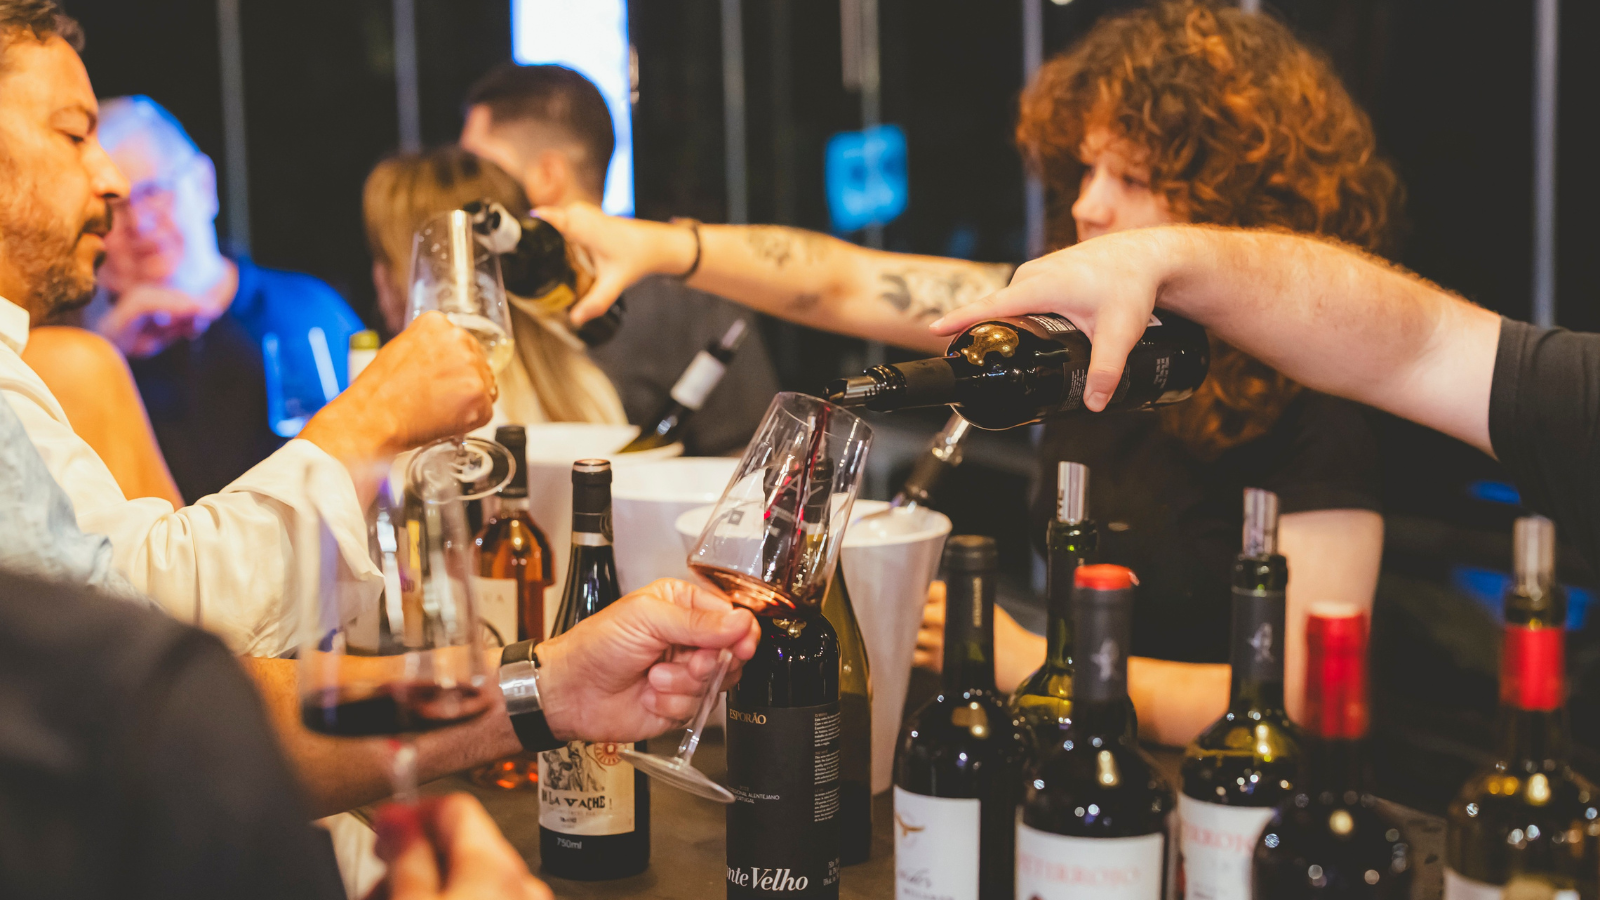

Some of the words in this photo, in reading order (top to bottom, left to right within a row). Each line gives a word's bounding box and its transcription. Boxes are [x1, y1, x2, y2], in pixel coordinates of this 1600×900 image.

[729, 708, 767, 725] ESPORÃO
[563, 795, 606, 810] VACHE
[748, 792, 780, 801] ALENTEJANO
[556, 836, 582, 849] 750ml
[751, 866, 809, 891] Velho
